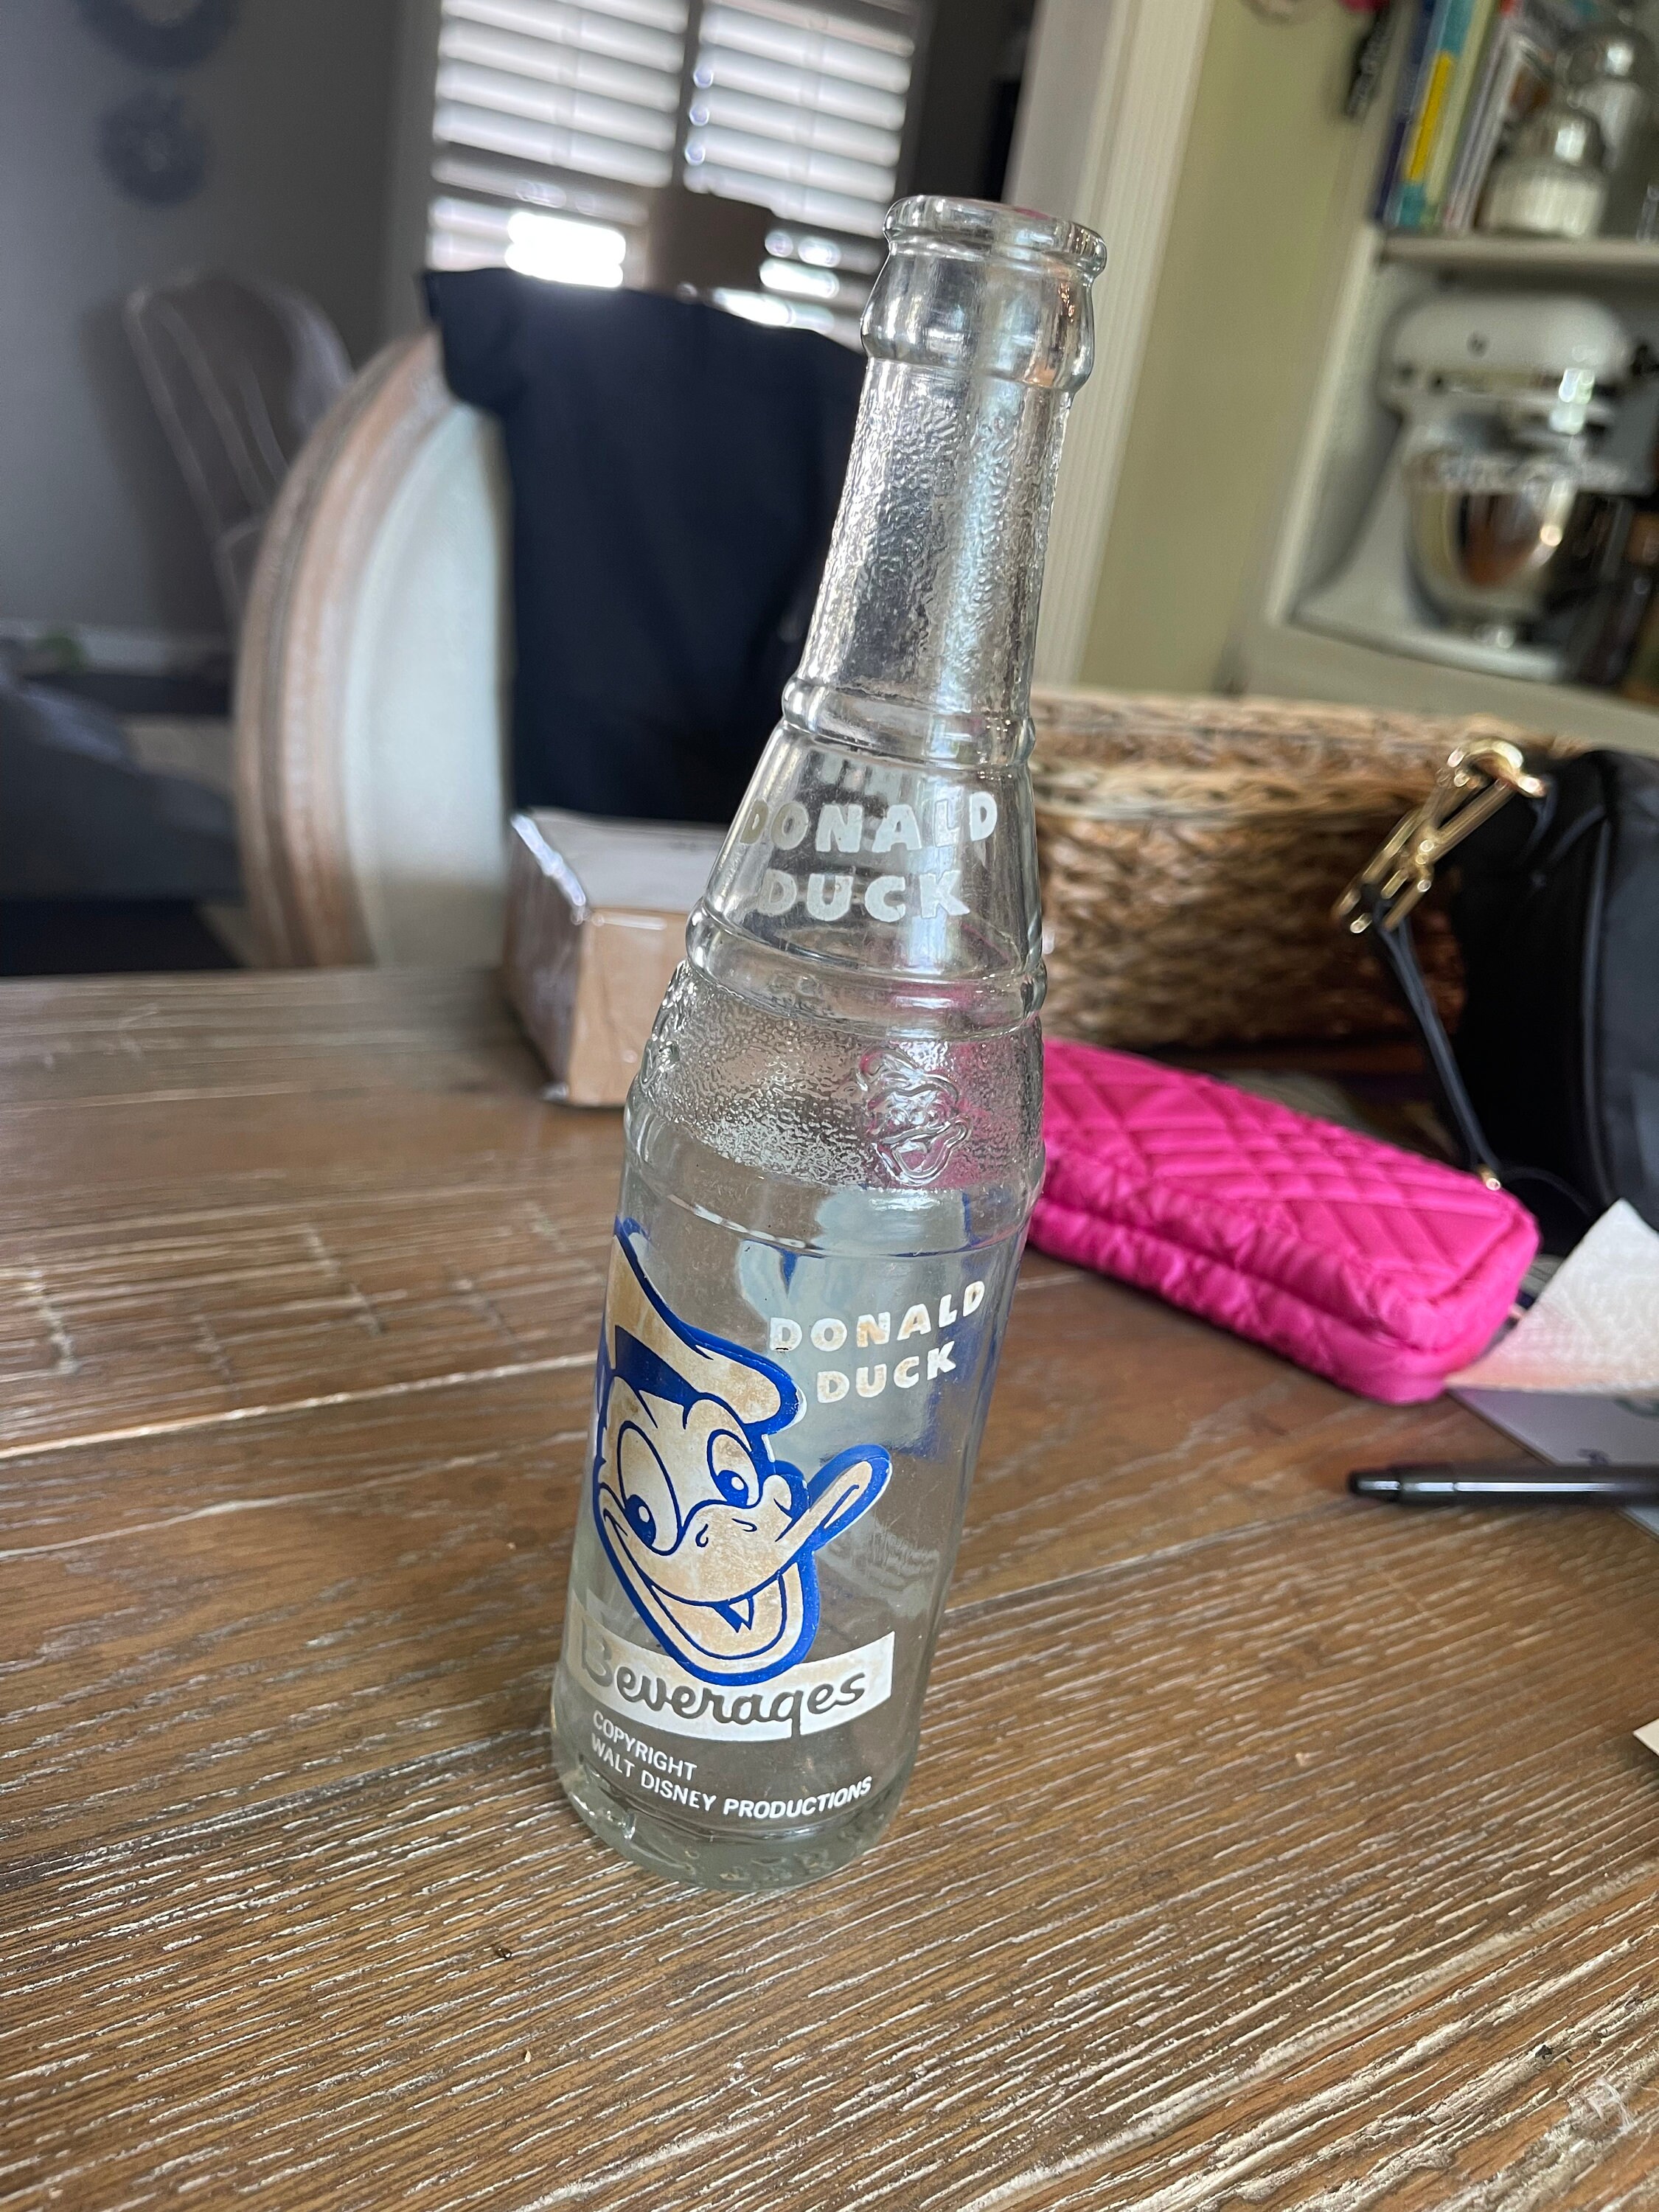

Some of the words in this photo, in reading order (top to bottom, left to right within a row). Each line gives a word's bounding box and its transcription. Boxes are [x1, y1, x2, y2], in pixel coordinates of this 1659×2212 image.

[740, 790, 998, 853] DONALD
[758, 869, 970, 922] DUCK
[769, 1280, 986, 1352] DONALD
[816, 1340, 957, 1403] DUCK
[581, 1616, 866, 1736] Beverages
[591, 1733, 636, 1778] WALT
[640, 1771, 717, 1812] DISNEY
[723, 1775, 873, 1820] PRODUCTIONS
[593, 1709, 698, 1781] COPYRIGHT
